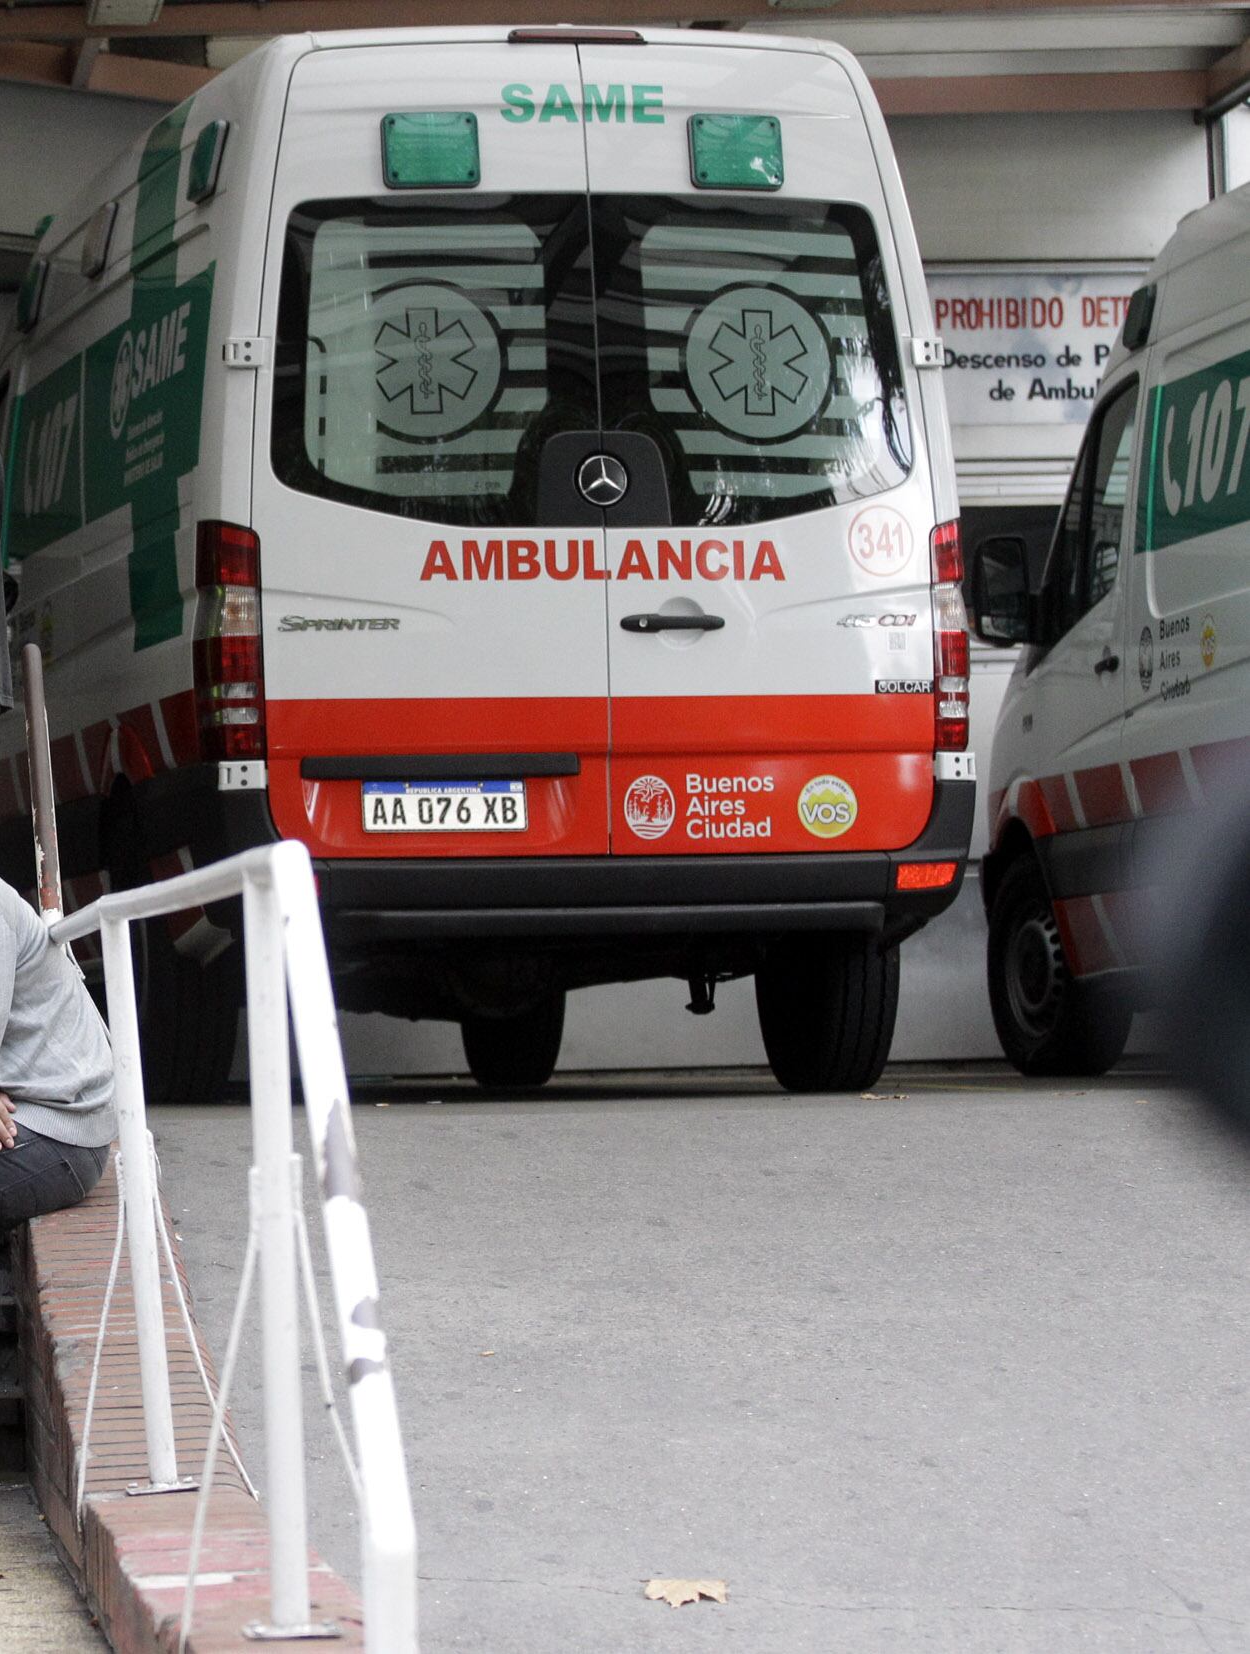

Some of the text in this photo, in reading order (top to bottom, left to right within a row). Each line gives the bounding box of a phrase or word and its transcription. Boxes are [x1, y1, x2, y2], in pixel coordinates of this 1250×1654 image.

[500, 83, 665, 124] SAME
[934, 297, 1064, 330] PROHIBIDO
[132, 301, 191, 399] SAME
[943, 348, 1046, 369] Descenso
[1056, 345, 1082, 367] de
[989, 379, 1015, 400] de
[33, 392, 79, 514] 107
[1183, 376, 1250, 508] 107
[858, 522, 904, 559] 341
[420, 539, 786, 581] AMBULANCIA
[1159, 616, 1190, 640] Buenos
[1159, 649, 1181, 672] Aires
[685, 773, 775, 794] Buenos
[372, 796, 518, 825] AA 076 XB
[685, 796, 746, 817] Aires
[801, 802, 851, 824] VOS
[686, 817, 772, 840] Ciudad
